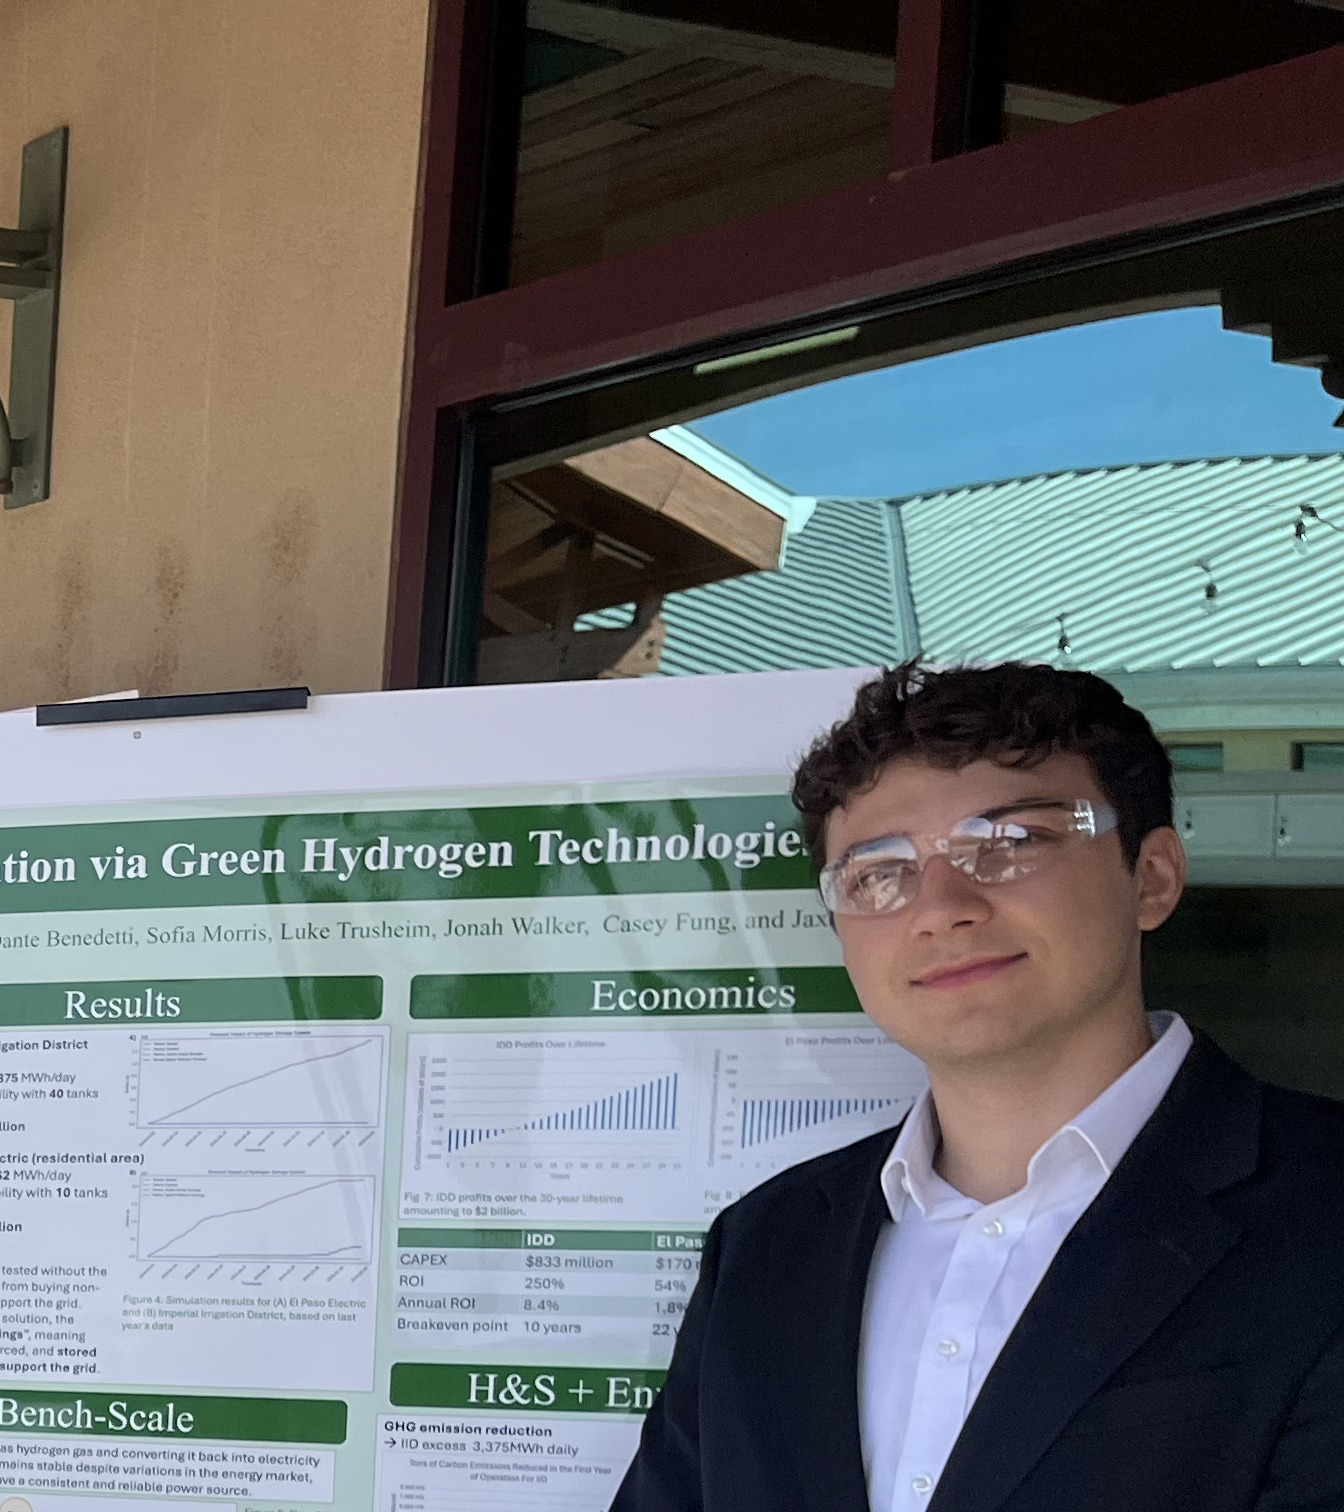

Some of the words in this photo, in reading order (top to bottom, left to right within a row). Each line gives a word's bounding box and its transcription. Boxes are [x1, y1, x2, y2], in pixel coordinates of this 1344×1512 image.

[90, 845, 147, 880] via
[162, 843, 285, 877] Green
[301, 836, 512, 881] Hydrogen
[529, 822, 809, 869] Technologie
[48, 928, 139, 947] Benedetti,
[147, 925, 195, 944] Sofia
[204, 923, 272, 942] Morris,
[281, 922, 330, 941] Luke
[337, 920, 436, 939] Trusheim,
[444, 917, 502, 937] Jonah
[512, 916, 589, 936] Walker,
[603, 914, 667, 937] Casey
[677, 913, 736, 935] Fung,
[746, 909, 784, 929] and
[65, 987, 180, 1019] Results
[590, 976, 795, 1011] Economics
[468, 1373, 555, 1406] H&S
[569, 1380, 593, 1404] +
